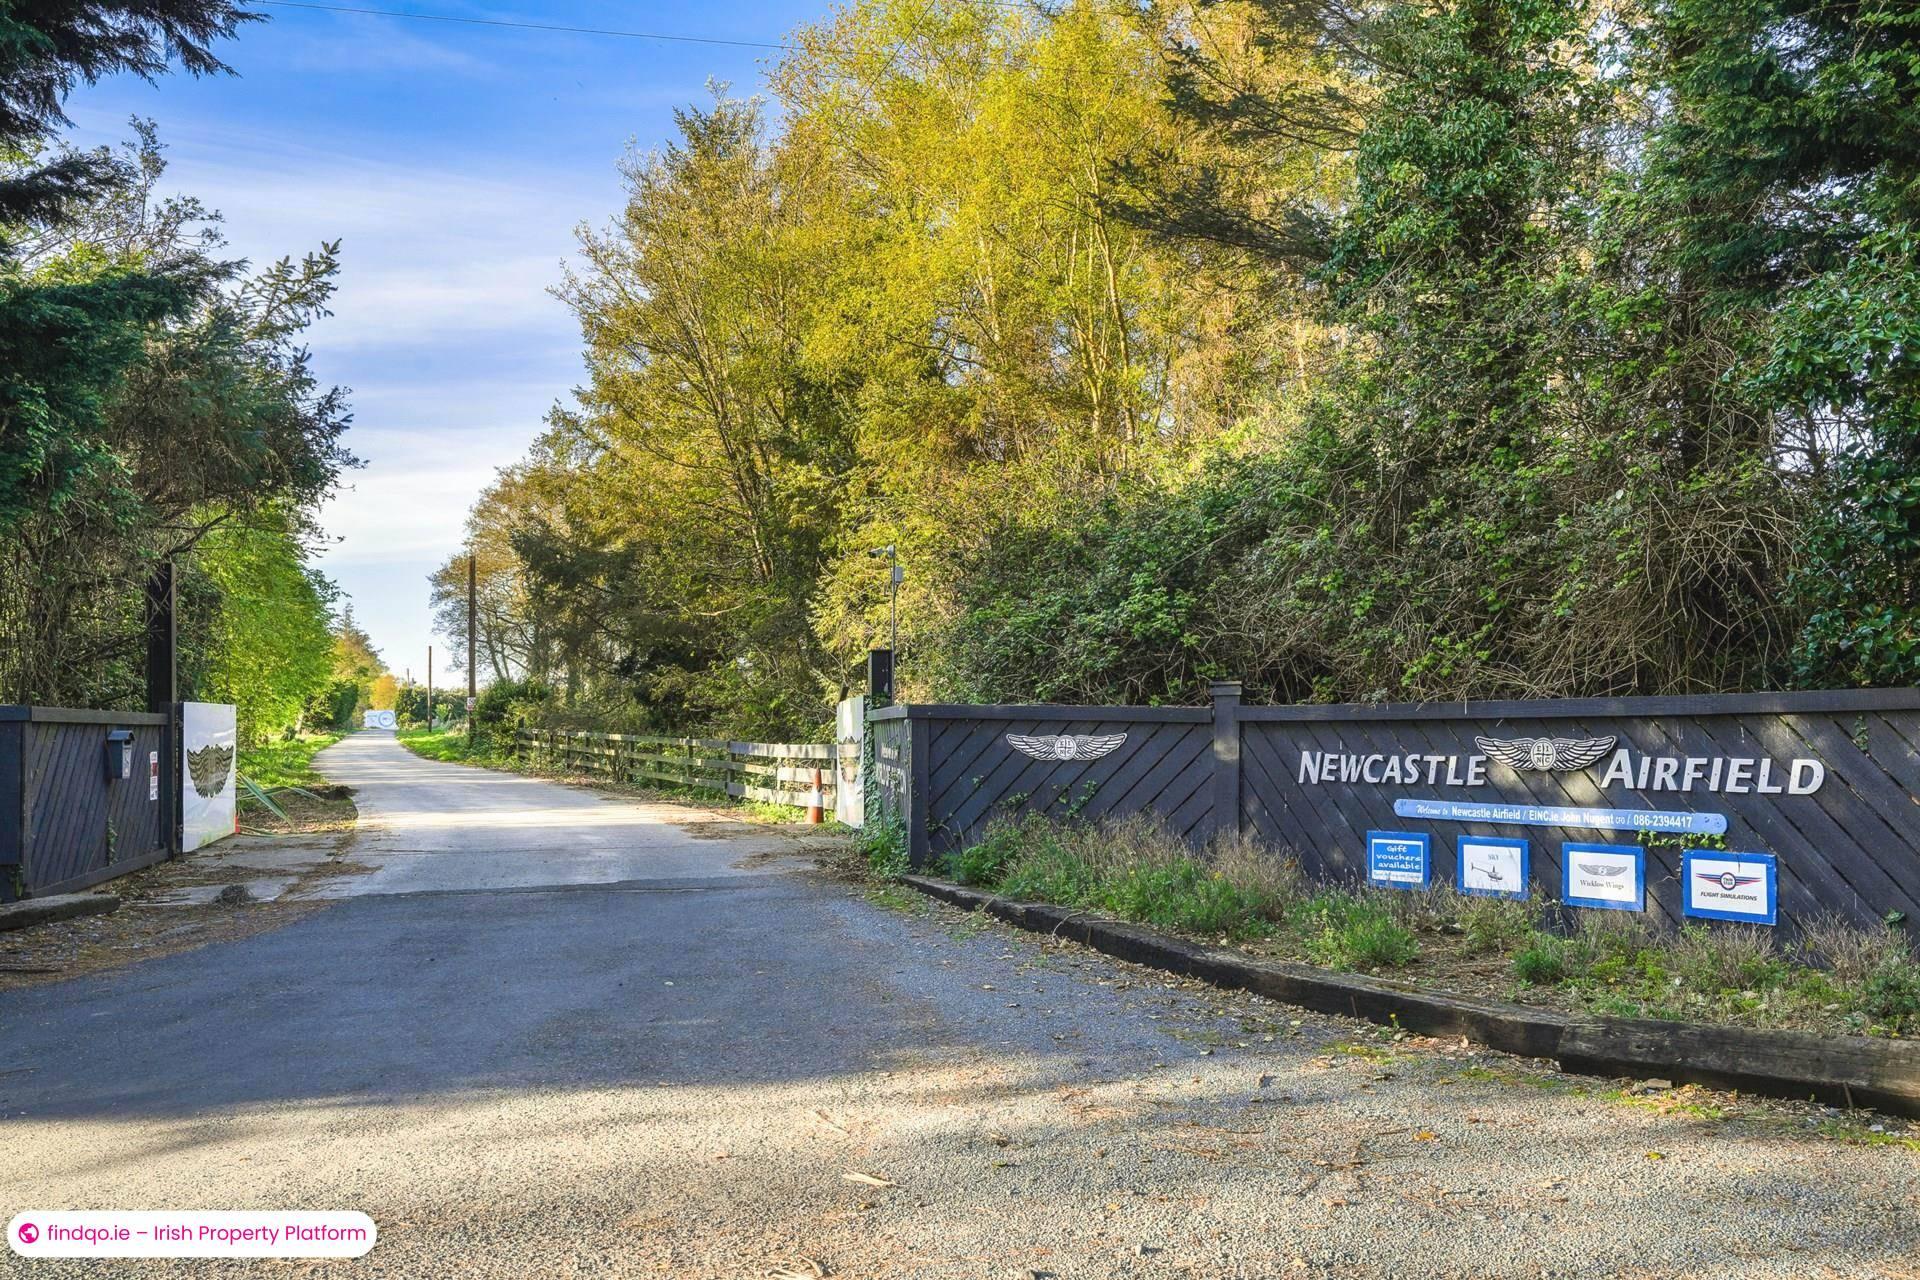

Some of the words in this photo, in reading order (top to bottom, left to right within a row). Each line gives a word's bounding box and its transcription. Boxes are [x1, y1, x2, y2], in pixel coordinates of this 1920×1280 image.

[1298, 750, 1487, 786] NEWCASTLE
[1600, 748, 1825, 795] AIRFIELD
[1451, 805, 1491, 818] Newcastle
[1492, 808, 1521, 820] Airfield
[1583, 811, 1614, 826] Nugent
[1633, 814, 1693, 829] 086-2394417
[1386, 844, 1408, 853] Gift
[1375, 853, 1422, 862] vouchers
[1378, 861, 1421, 870] available
[1579, 879, 1605, 888] Wicklow
[1605, 881, 1625, 890] Wings
[1700, 891, 1720, 899] FLIGHT
[1720, 893, 1758, 902] SIMULATIONS
